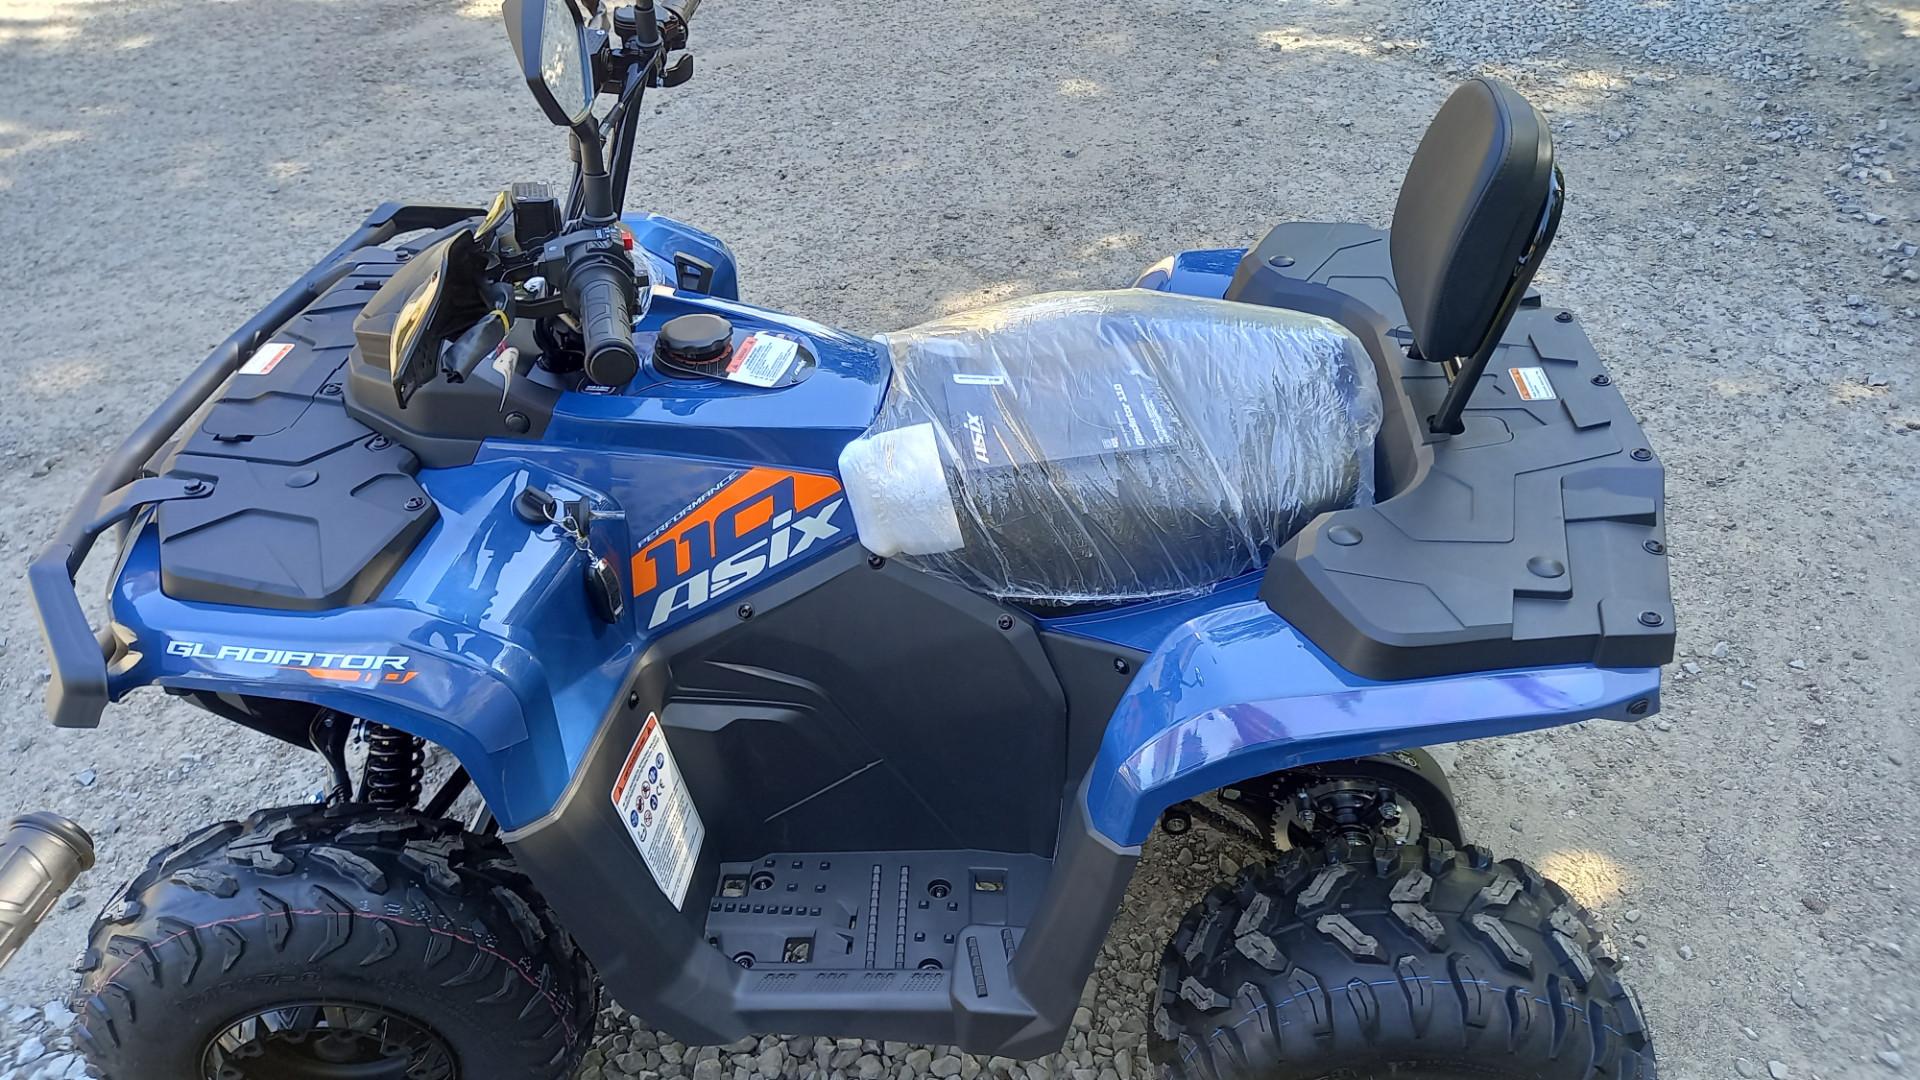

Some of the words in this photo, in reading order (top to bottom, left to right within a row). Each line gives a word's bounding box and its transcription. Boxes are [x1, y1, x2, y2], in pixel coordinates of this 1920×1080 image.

[637, 470, 738, 549] PERFORMANCE
[644, 475, 799, 592] 110
[166, 640, 410, 671] GLADIATOR
